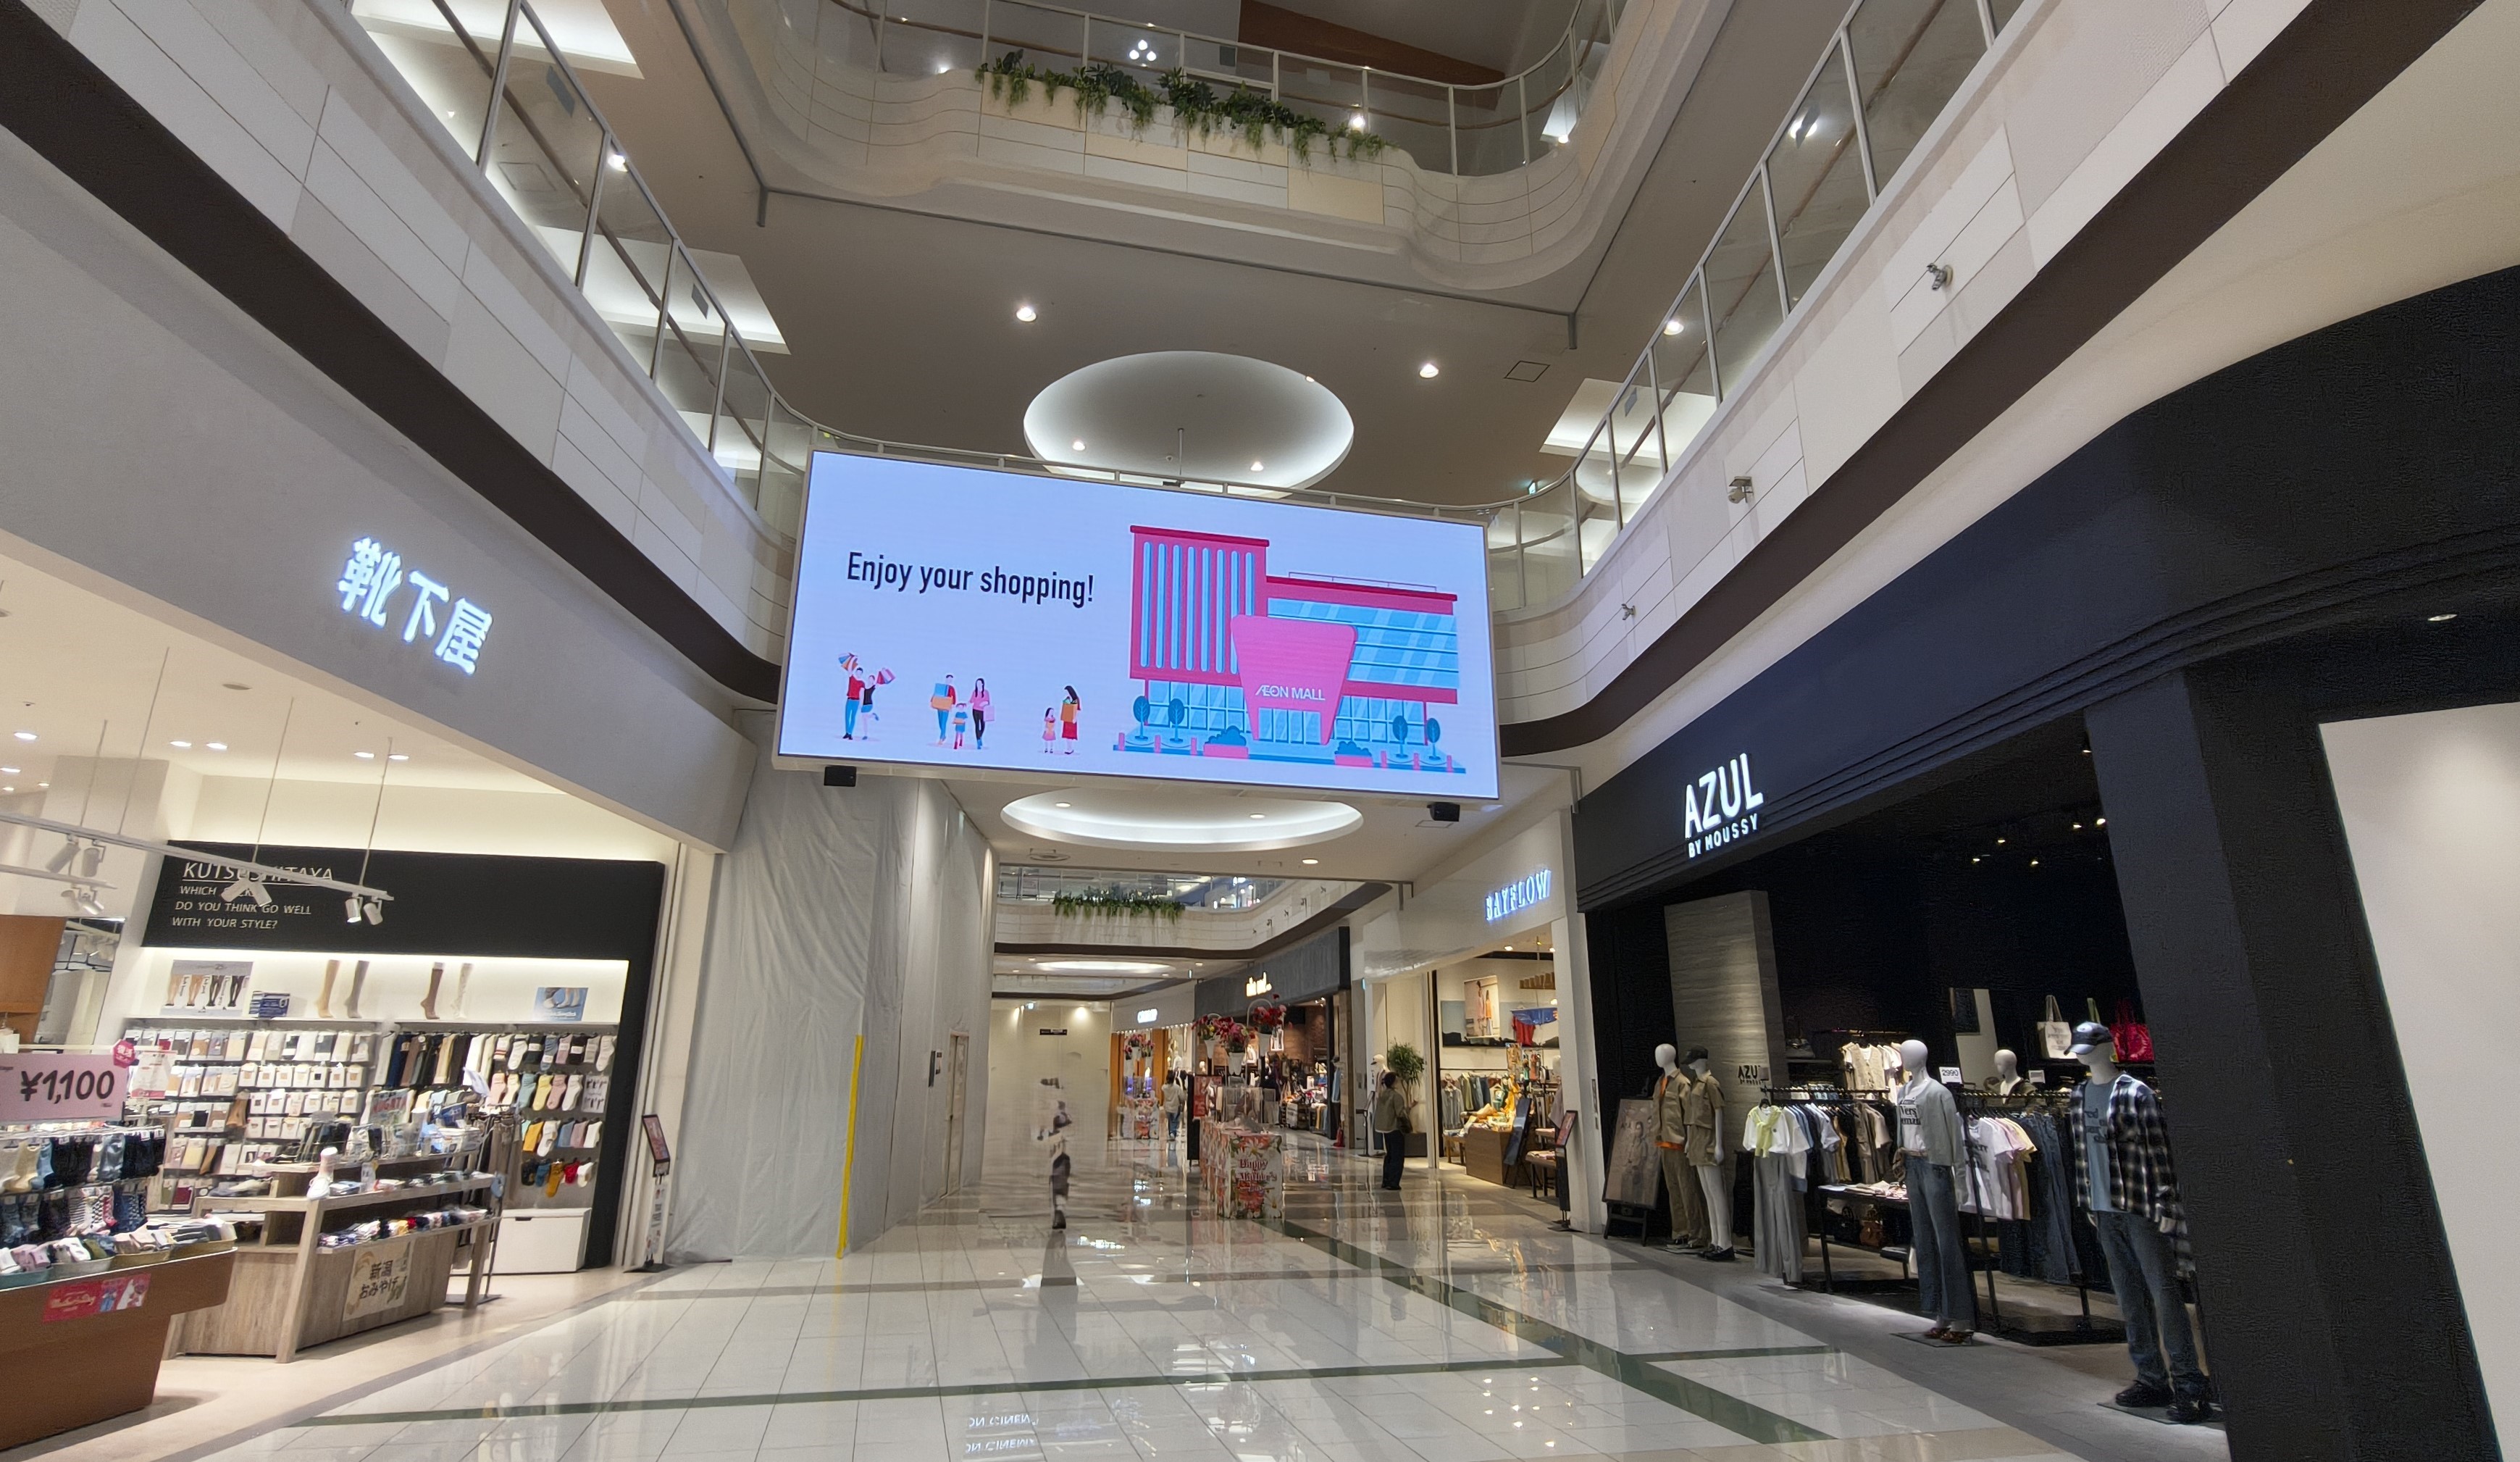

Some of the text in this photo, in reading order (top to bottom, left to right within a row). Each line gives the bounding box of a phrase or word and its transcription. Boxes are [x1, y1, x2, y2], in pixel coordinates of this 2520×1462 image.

[847, 551, 1094, 609] Enjoy your shopping!
[338, 537, 493, 675] 靴下屋
[1291, 687, 1326, 701] MALL
[1685, 753, 1764, 838] AZUL
[1688, 813, 1757, 858] BY MOUSSY
[175, 901, 311, 914] DO YOU THINK GO WELL
[180, 886, 217, 896] WHICH
[1486, 869, 1552, 921] BAYFLOW
[172, 916, 277, 930] WITH YOUR STYLE?
[20, 1070, 114, 1104] ¥1,100
[1738, 1065, 1761, 1079] AZU
